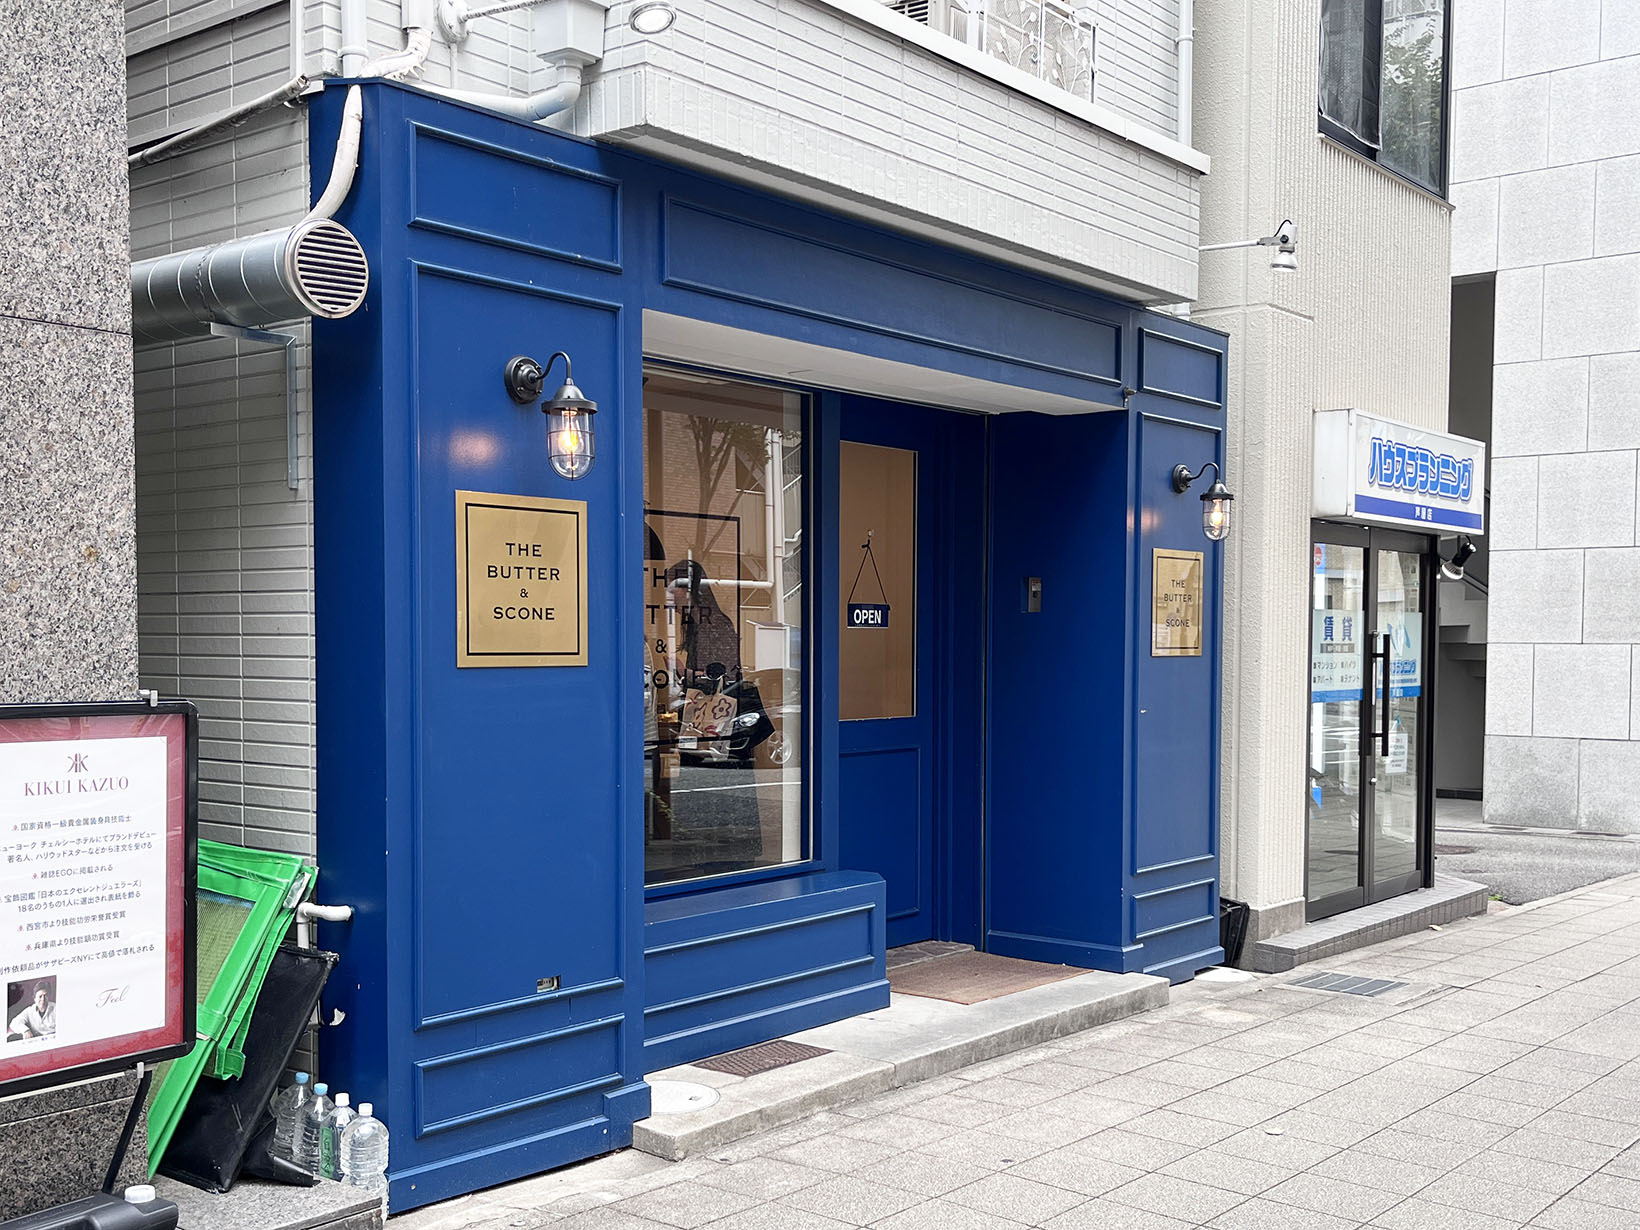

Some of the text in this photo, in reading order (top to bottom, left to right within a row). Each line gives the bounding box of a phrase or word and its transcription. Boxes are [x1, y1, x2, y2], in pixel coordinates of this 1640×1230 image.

[1368, 437, 1473, 502] ハウスプランニング
[505, 542, 542, 557] THE
[487, 565, 560, 581] BUTTER
[1171, 579, 1186, 589] THE
[519, 588, 529, 598] &
[1163, 593, 1193, 603] BUTTER
[493, 606, 555, 621] SCONE
[853, 608, 882, 625] OPEN
[1165, 618, 1191, 628] SCONE
[1323, 615, 1353, 641] 賃貸
[655, 638, 667, 654] &
[24, 776, 130, 797] KIKUI KAZUO
[0, 841, 37, 852] ューヨーク
